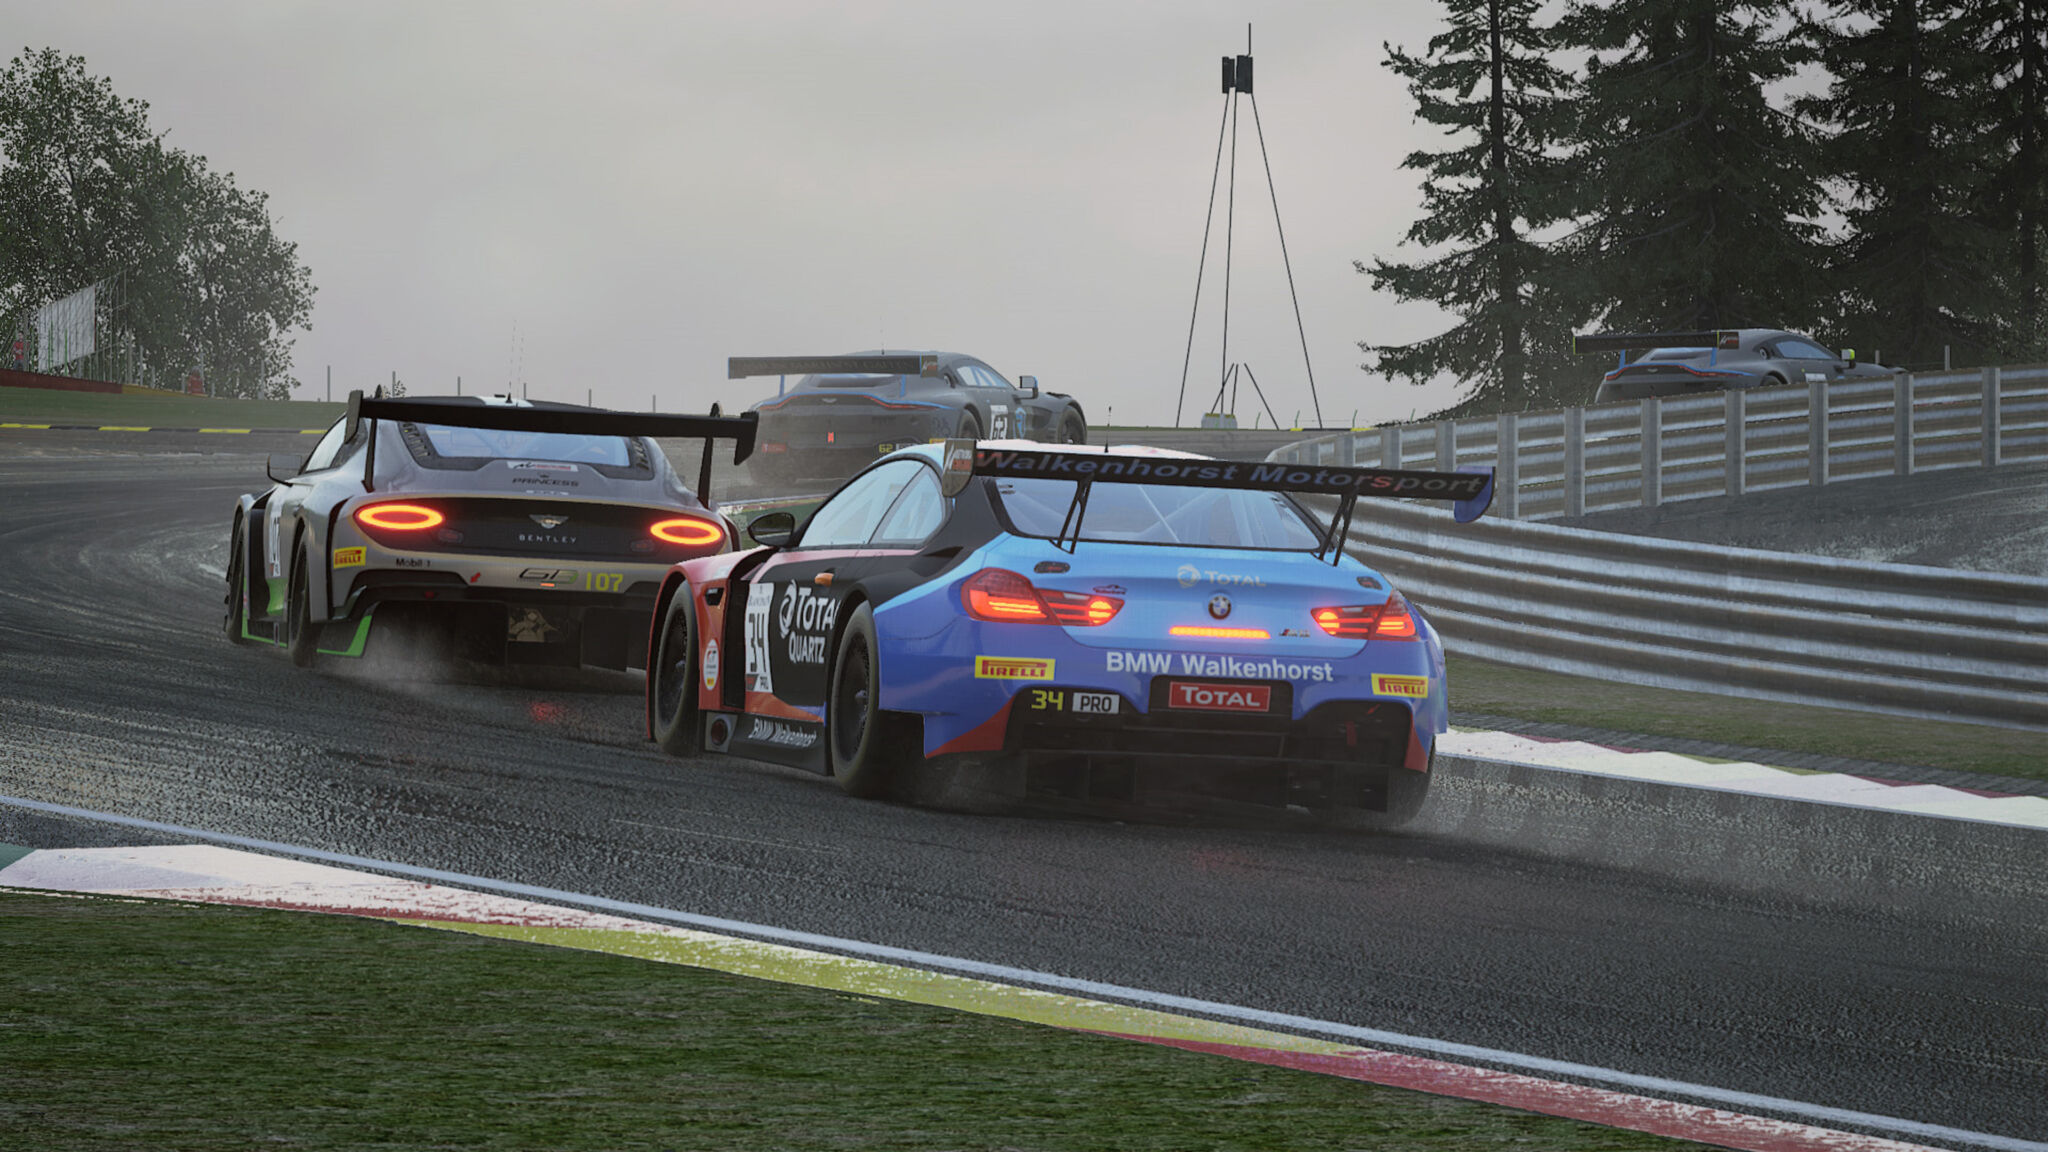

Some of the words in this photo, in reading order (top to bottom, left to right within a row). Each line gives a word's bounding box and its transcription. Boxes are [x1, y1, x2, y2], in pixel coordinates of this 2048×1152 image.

[879, 444, 893, 453] 62
[977, 451, 1238, 481] Walkenhorst
[1250, 464, 1485, 493] Motorsport
[519, 534, 576, 543] BENTLEY
[396, 558, 422, 567] Mobil
[586, 572, 624, 592] 107
[1204, 570, 1267, 587] TOTAL
[749, 613, 767, 674] 34
[789, 631, 825, 664] QUARTZ
[981, 659, 1048, 678] PIRELLI
[1106, 651, 1172, 675] BMW
[1181, 654, 1334, 682] Walkenhorst
[1180, 685, 1261, 707] TOTAL
[1378, 677, 1426, 695] PIRELLI
[1031, 689, 1064, 711] 34
[1079, 695, 1112, 712] PRO
[748, 717, 774, 740] BMW
